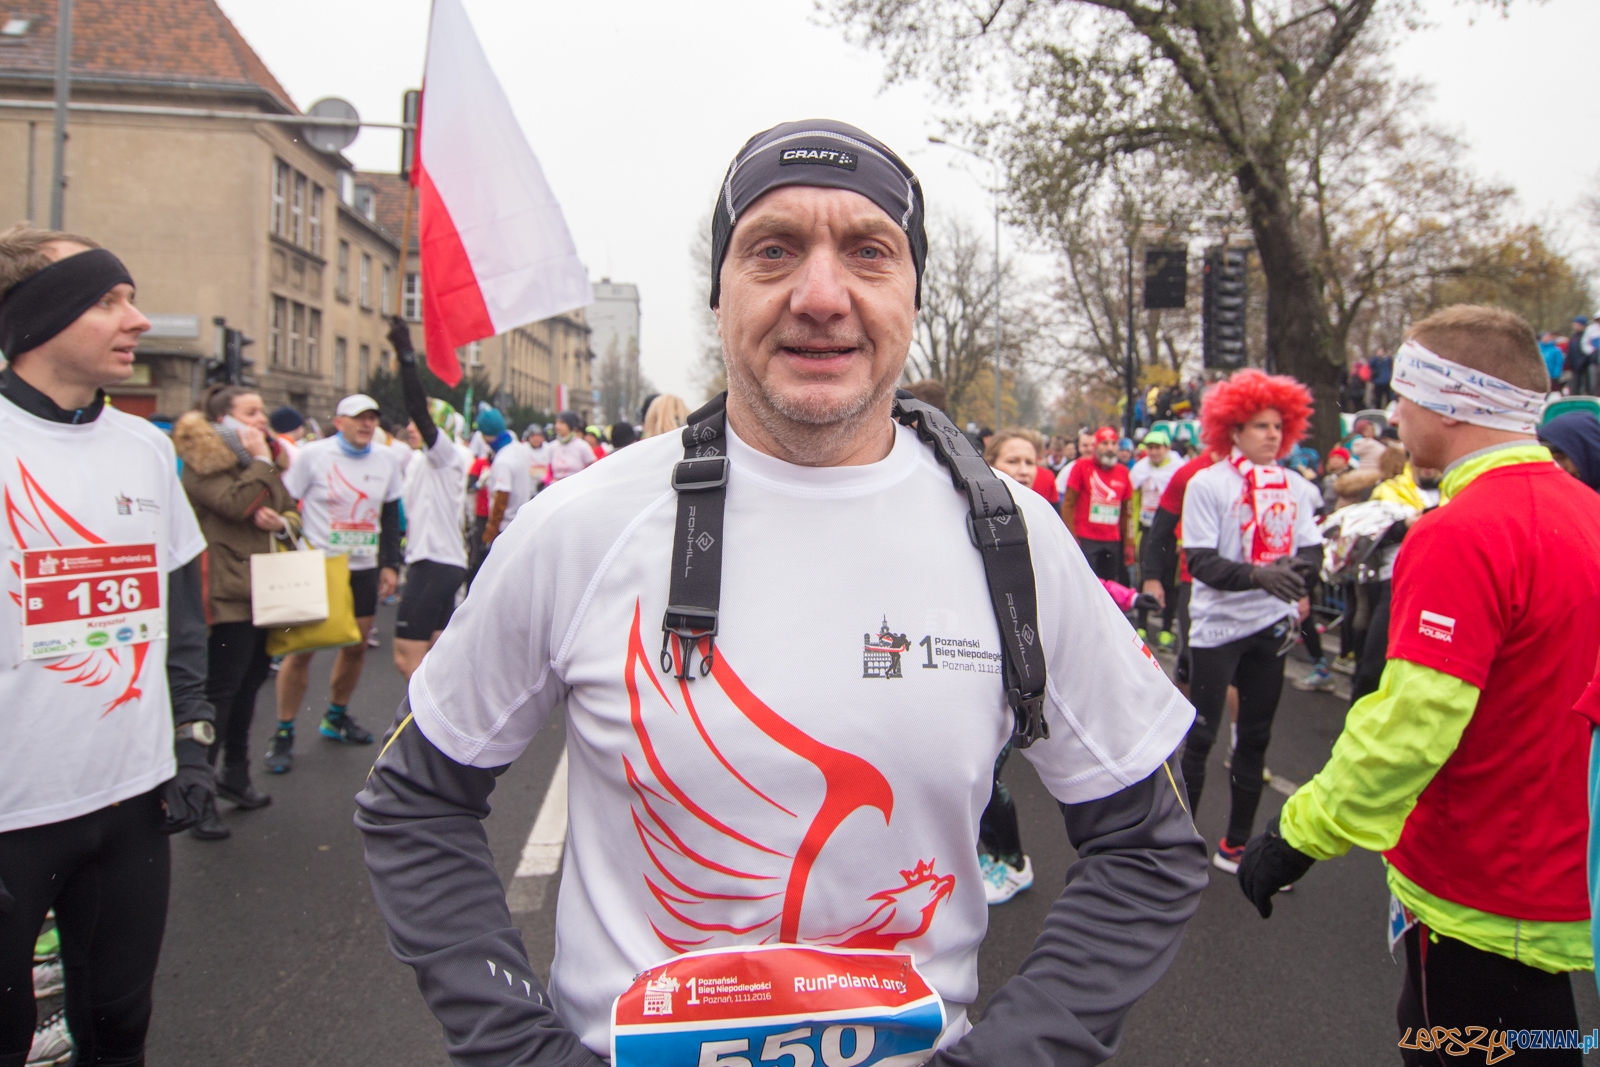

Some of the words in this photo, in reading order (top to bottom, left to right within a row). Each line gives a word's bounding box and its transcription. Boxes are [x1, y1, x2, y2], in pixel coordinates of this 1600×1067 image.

[783, 150, 839, 160] CRAFT
[684, 505, 697, 579] RONHILL
[28, 597, 43, 610] B
[67, 577, 141, 616] 136
[1005, 592, 1031, 679] RONHILL
[1418, 626, 1452, 643] POLSKA
[32, 639, 62, 648] GRUPA
[934, 637, 980, 649] Poznański
[919, 635, 938, 669] 1
[935, 648, 956, 658] Bieg
[698, 976, 738, 986] Poznański
[698, 986, 715, 995] Bieg
[716, 981, 772, 994] Niepodległości
[794, 972, 907, 994] RunPoland.org
[685, 977, 700, 1005] 1
[734, 992, 772, 1002] 11.11.2016
[696, 1024, 876, 1067] 550
